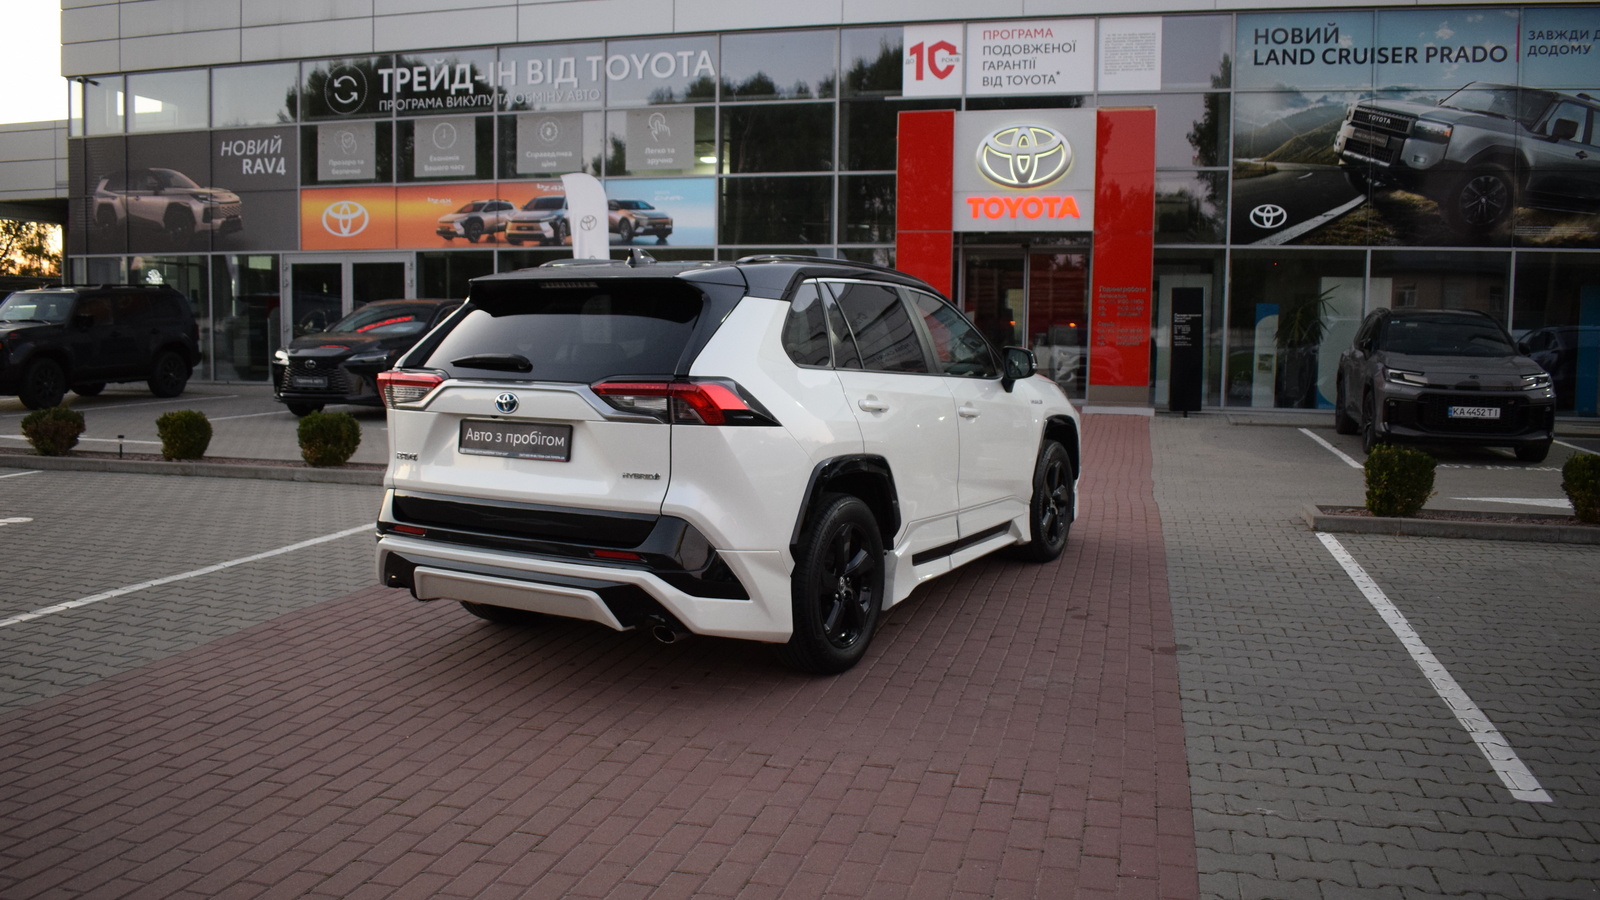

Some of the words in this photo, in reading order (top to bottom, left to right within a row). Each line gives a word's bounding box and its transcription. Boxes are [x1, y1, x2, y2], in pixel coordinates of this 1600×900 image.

[983, 28, 1054, 41] ПРОГРАМА
[1254, 23, 1339, 44] НОВИЙ
[1528, 30, 1588, 41] ЗАВЖДИ
[983, 40, 1077, 57] ПОДОВЖЕНОЇ
[1254, 48, 1315, 66] LAND
[1322, 46, 1418, 64] CRUISER
[1426, 45, 1508, 63] PRADO
[1527, 44, 1592, 57] ДОДОМУ
[378, 58, 516, 95] ТРЕЙД-ІН
[527, 57, 579, 89] ВІД
[586, 50, 716, 81] TOYOTA
[983, 57, 1037, 71] ГАРАНТІЇ
[983, 76, 1004, 89] ВІД
[379, 97, 444, 111] ПРОГРАМА
[446, 94, 493, 109] ВИКУПУ
[495, 92, 512, 106] ТА
[514, 90, 564, 106] ОБМІНУ
[566, 88, 600, 102] АВТО
[1368, 115, 1391, 124] TOYOTA
[220, 135, 283, 156] НОВИЙ
[242, 157, 286, 176] RAV4
[967, 196, 1080, 219] TOYOTA
[465, 427, 493, 442] Авто
[495, 432, 502, 442] з
[506, 431, 565, 446] пробігом
